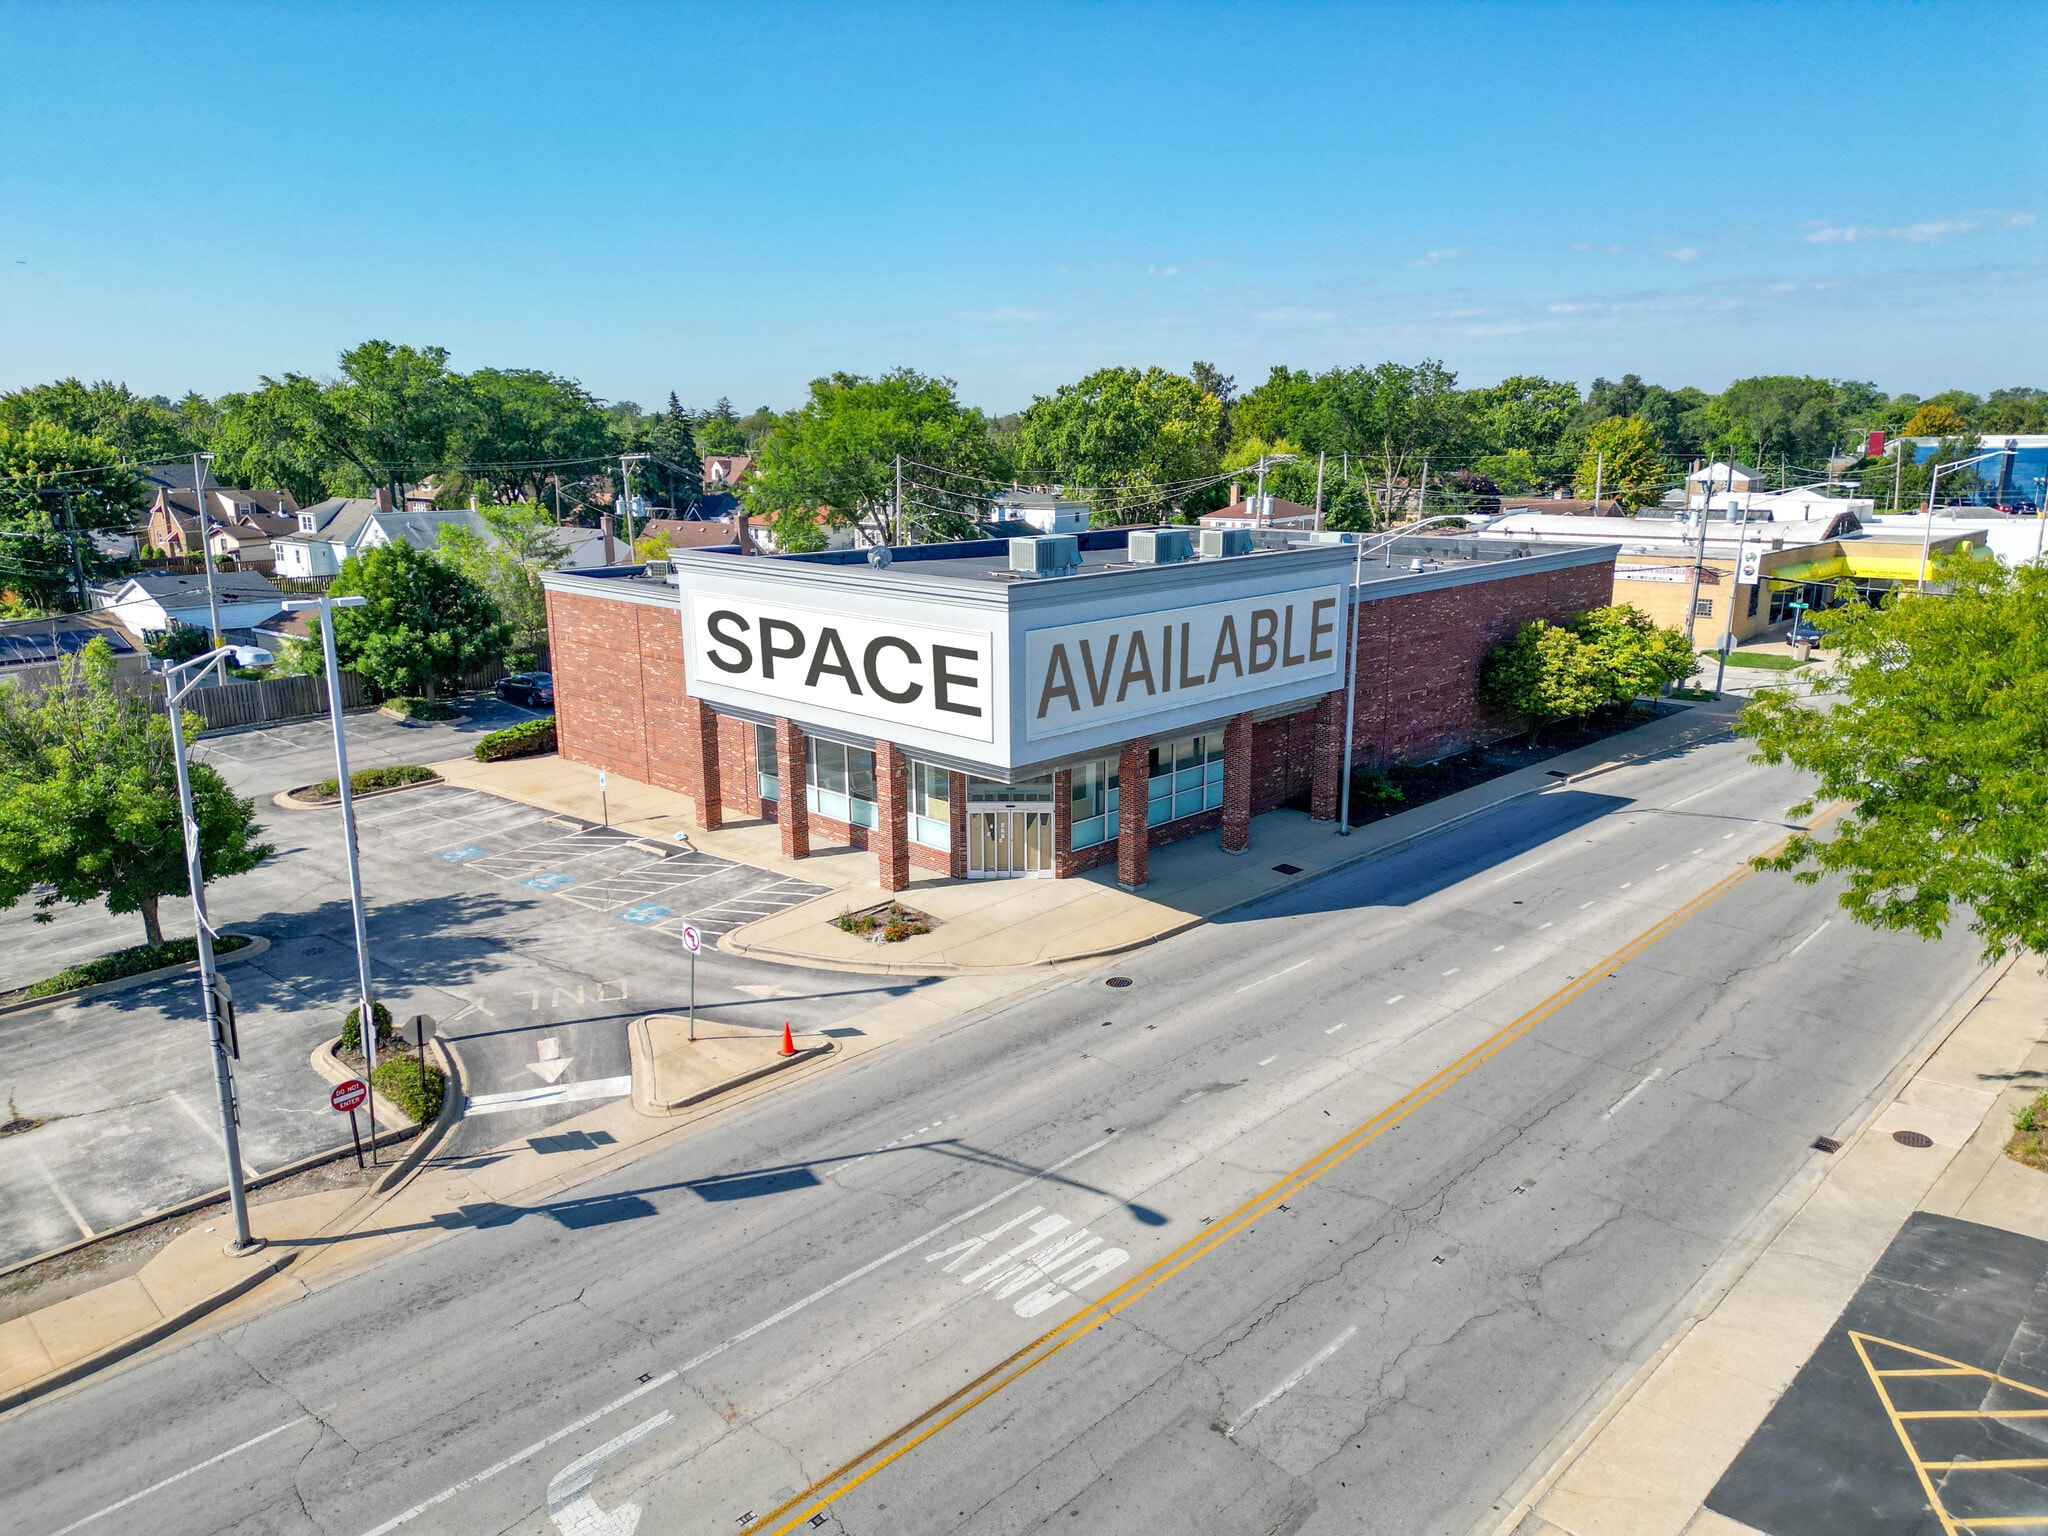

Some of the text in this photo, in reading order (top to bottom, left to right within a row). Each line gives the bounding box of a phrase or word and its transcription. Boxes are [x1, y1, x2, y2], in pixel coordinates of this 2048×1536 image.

[706, 610, 982, 718] SPACE
[1037, 598, 1336, 720] AVAILABLE
[336, 1084, 360, 1097] DO NOT
[340, 1097, 360, 1108] ENTER
[925, 1206, 1130, 1318] ONLY
